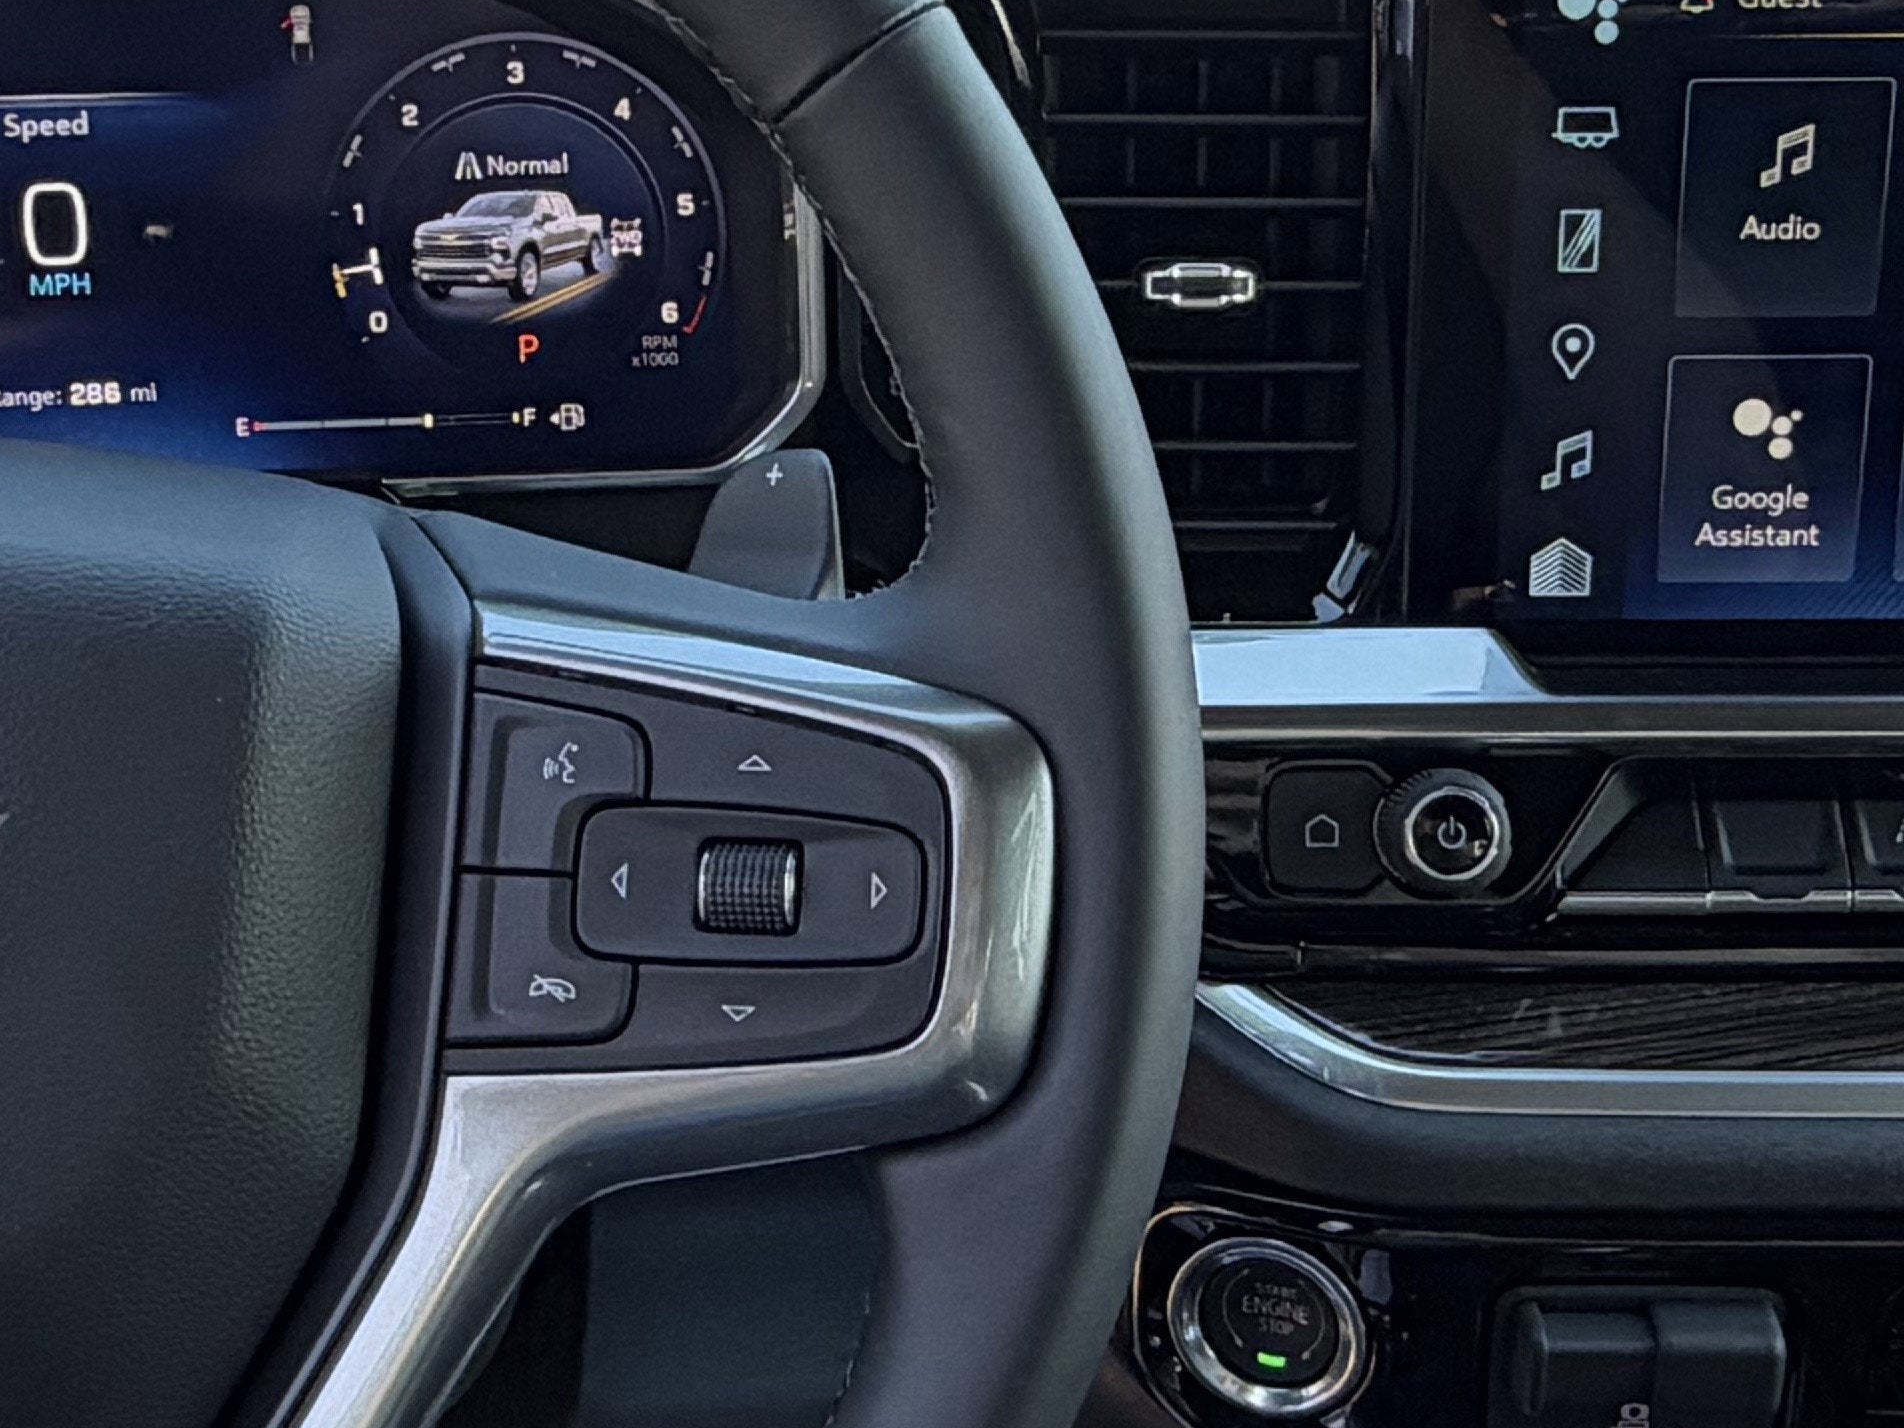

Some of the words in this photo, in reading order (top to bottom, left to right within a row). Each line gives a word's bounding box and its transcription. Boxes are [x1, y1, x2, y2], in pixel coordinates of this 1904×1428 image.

[506, 61, 526, 85] 3
[400, 104, 421, 127] 2
[613, 97, 633, 121] 4
[2, 110, 91, 143] Speed
[486, 152, 570, 177] Normal
[351, 203, 365, 225] 1
[676, 193, 696, 217] 5
[21, 180, 89, 268] 0
[1739, 214, 1821, 241] Audio
[28, 272, 93, 297] MPH
[368, 311, 388, 334] 0
[660, 301, 679, 324] 6
[517, 334, 540, 364] P
[641, 334, 679, 350] RPM
[129, 381, 159, 403] mi
[234, 417, 251, 438] E
[522, 408, 538, 427] F
[1710, 483, 1811, 516] Google
[1694, 521, 1821, 549] Assistant
[1241, 1294, 1309, 1326] ENGINE
